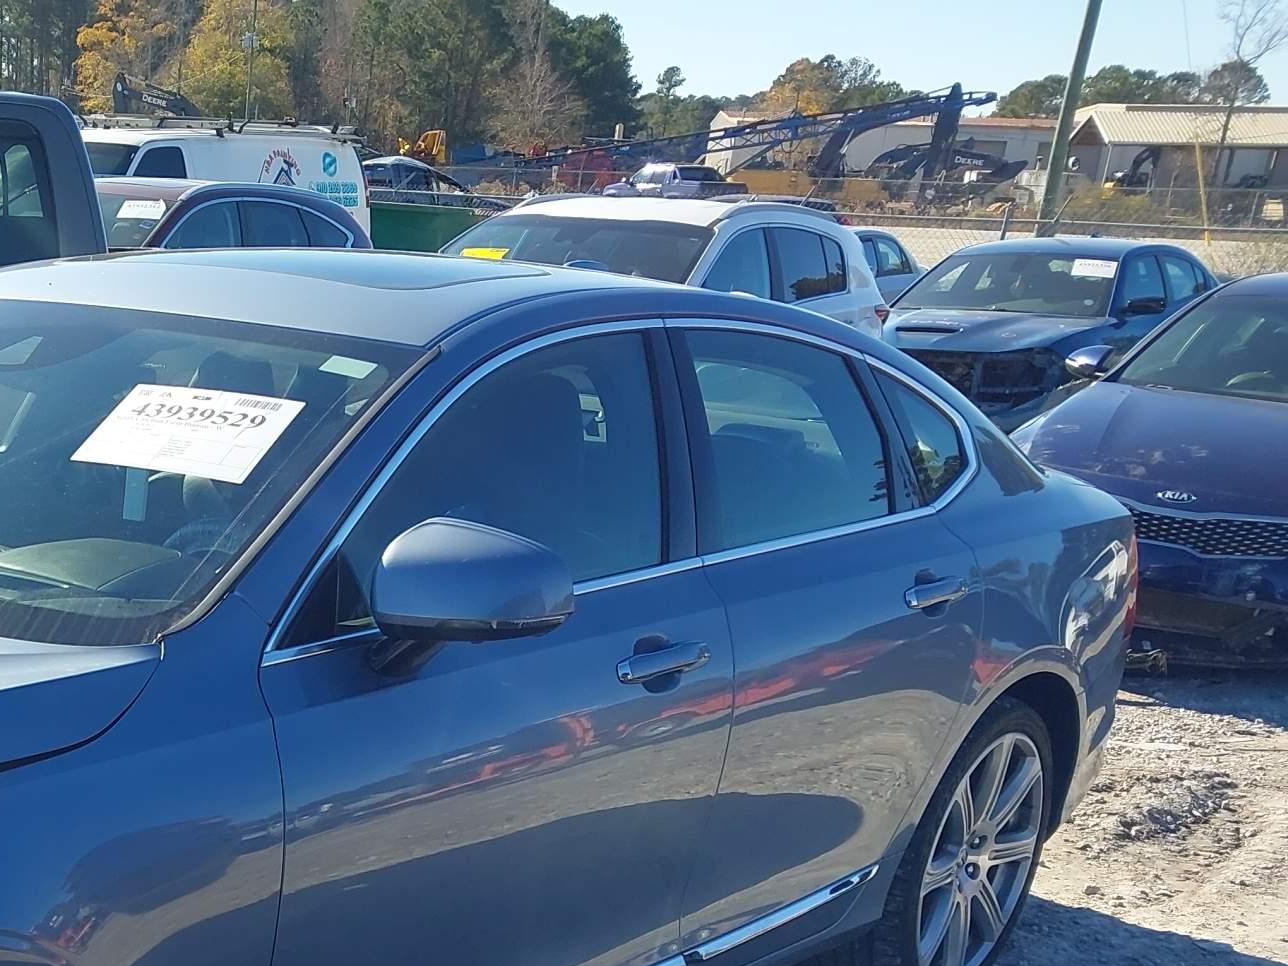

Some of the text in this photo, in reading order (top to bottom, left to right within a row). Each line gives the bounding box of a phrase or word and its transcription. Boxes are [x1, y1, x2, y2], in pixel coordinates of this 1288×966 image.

[142, 94, 168, 107] DEERE
[954, 155, 985, 166] DEERE
[131, 402, 267, 429] 43939529
[1164, 490, 1188, 501] KIA
